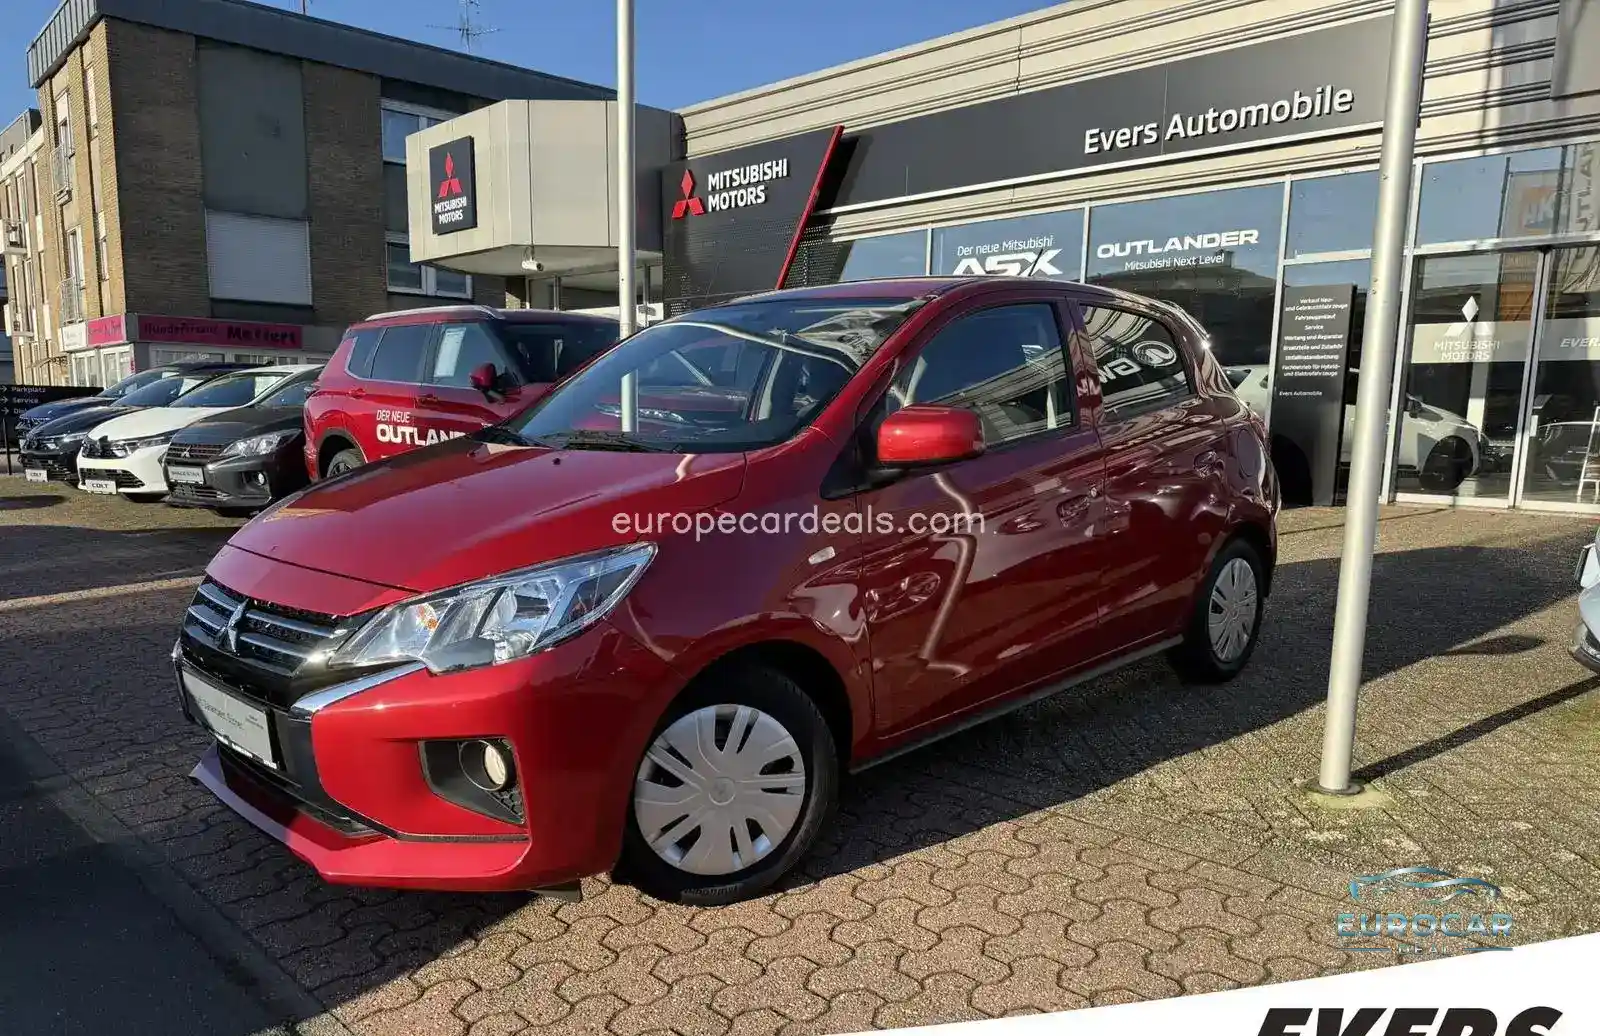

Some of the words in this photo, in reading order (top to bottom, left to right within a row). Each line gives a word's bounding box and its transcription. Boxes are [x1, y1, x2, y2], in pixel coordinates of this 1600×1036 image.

[1084, 121, 1158, 154] Evers
[1165, 85, 1354, 141] Automobile
[707, 158, 788, 191] MITSUBISHI
[434, 196, 467, 214] MITSUBISHI
[708, 185, 766, 212] MOTORS
[438, 209, 463, 224] MOTORS
[957, 245, 974, 257] Der
[975, 243, 1000, 254] neue
[1002, 235, 1054, 251] Mitsubishi
[1097, 229, 1259, 259] OUTLANDER
[953, 249, 1063, 276] ASX
[1124, 256, 1171, 271] Mitsubishi
[1173, 255, 1196, 268] Next
[1199, 253, 1225, 266] Level
[1433, 340, 1501, 351] MITSUBISHI
[1560, 337, 1600, 348] EVER
[1441, 352, 1491, 361] MOTORS
[11, 386, 46, 394] Parkplatz
[376, 410, 390, 421] DER
[391, 411, 411, 423] NEUE
